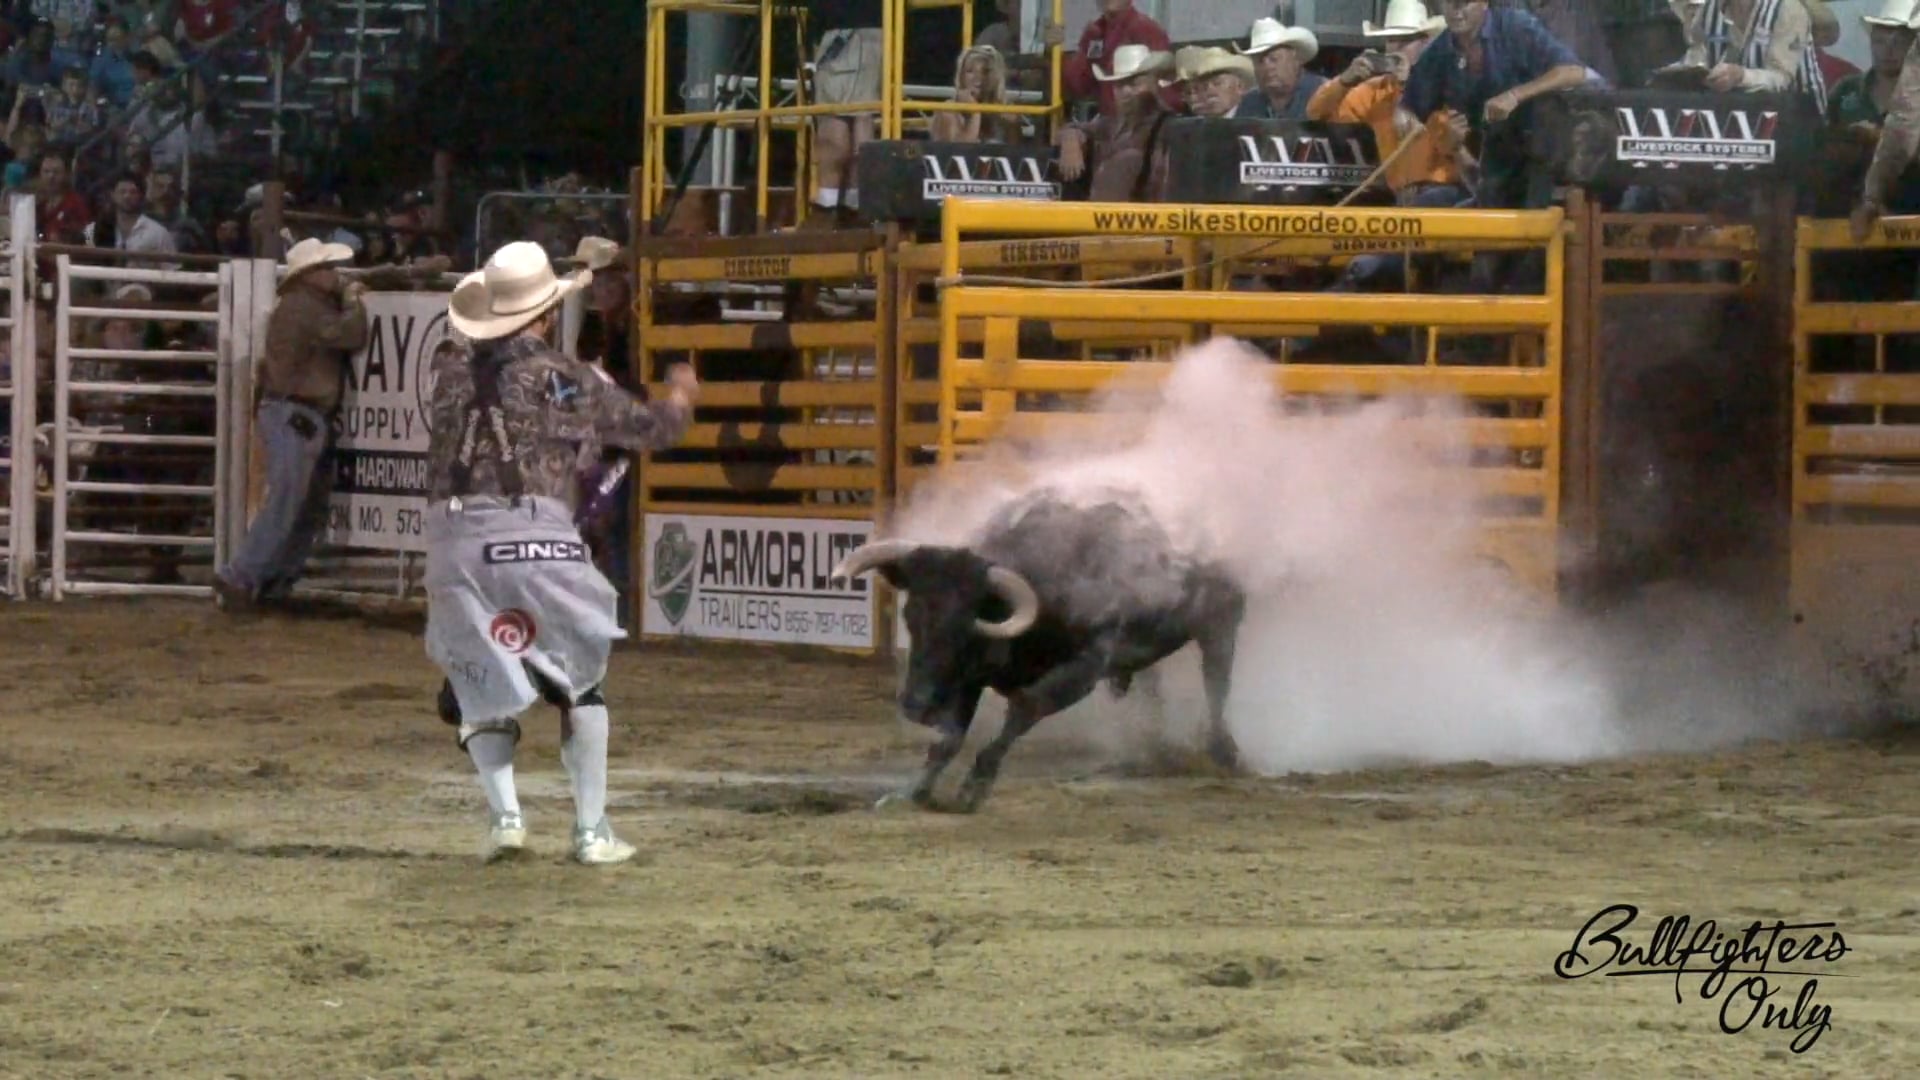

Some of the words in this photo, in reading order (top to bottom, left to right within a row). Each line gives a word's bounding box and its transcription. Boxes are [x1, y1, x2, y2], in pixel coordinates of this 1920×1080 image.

[1627, 141, 1700, 152] LIVESTOCK
[1705, 144, 1766, 154] SYSTEMS
[1250, 167, 1318, 177] LIVESTOCK
[931, 183, 998, 194] LIVESTOCK
[1093, 210, 1423, 236] www.sikestonrodeo.com
[354, 456, 428, 489] HARDWAR
[396, 507, 428, 536] 573-
[700, 528, 805, 589] ARMOR
[811, 531, 867, 592] LITE
[698, 597, 781, 632] TRAILERS
